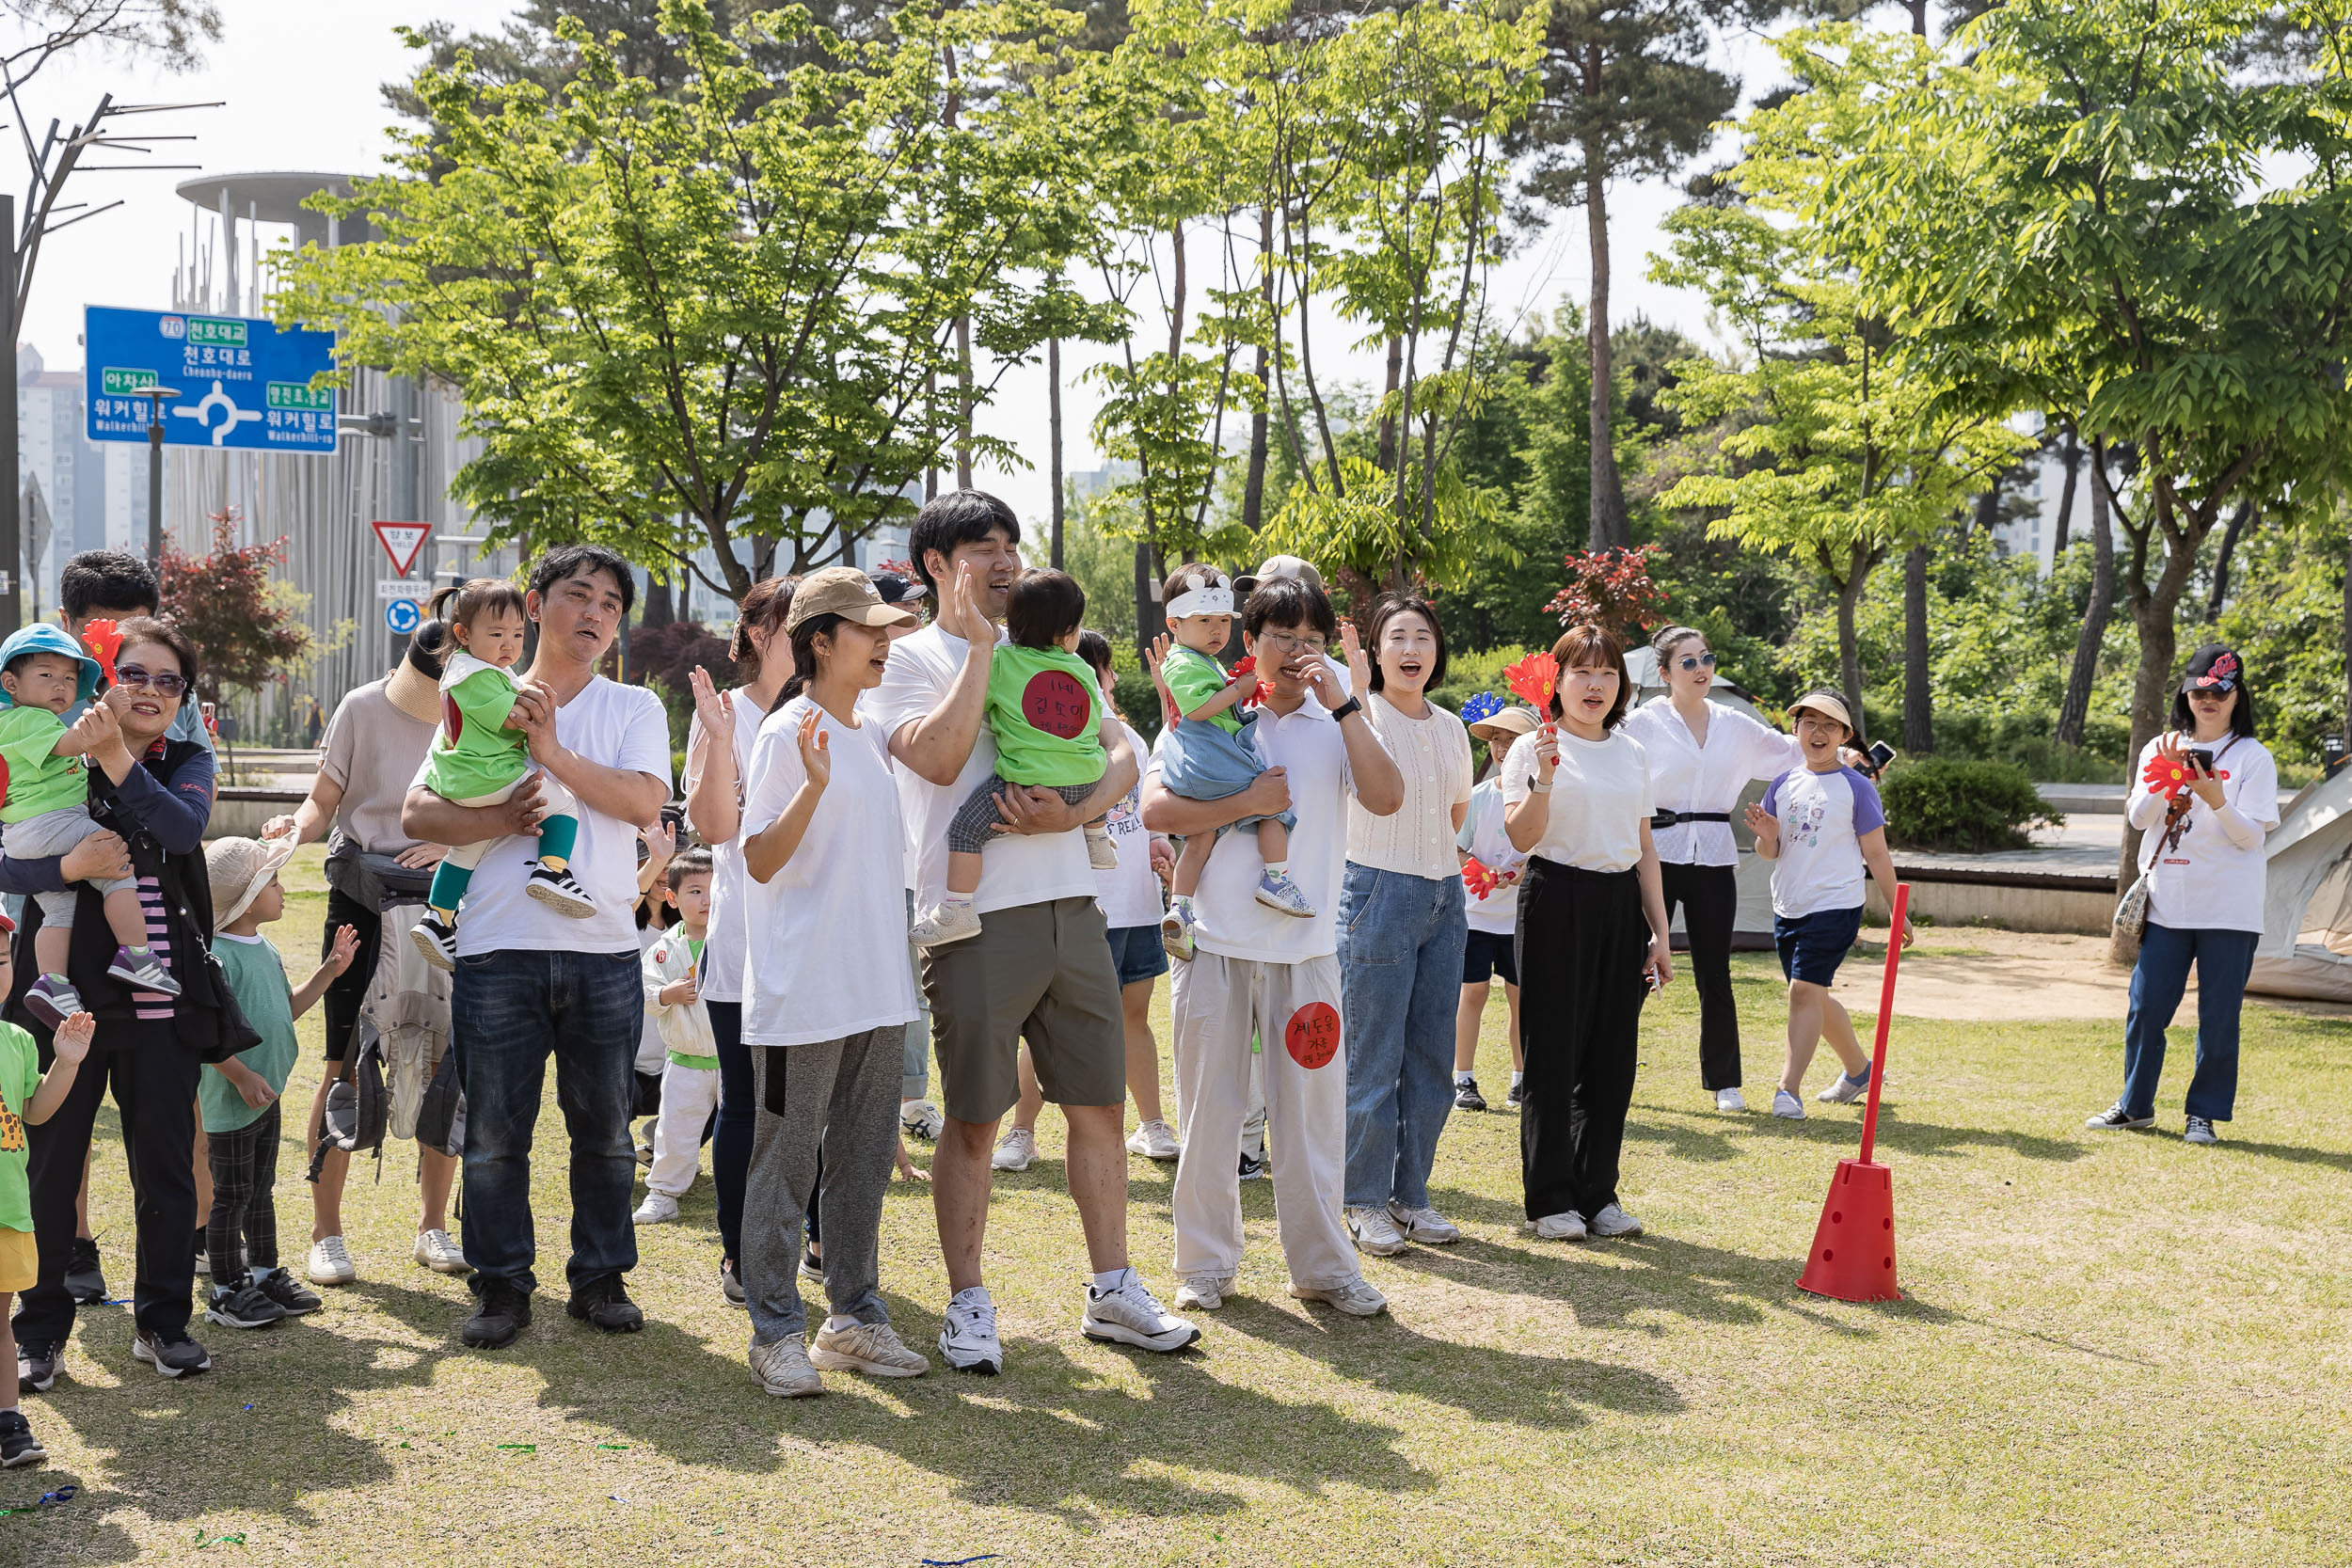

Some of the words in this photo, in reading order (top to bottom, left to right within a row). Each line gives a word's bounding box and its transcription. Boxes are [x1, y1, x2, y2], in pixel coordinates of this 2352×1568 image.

[165, 322, 182, 336] 70
[191, 322, 246, 341] 천호대교
[183, 344, 252, 366] 천호대로
[183, 364, 253, 381] Cheonho-daero
[94, 399, 167, 422] 워커힐로
[96, 420, 151, 433] Walkerhill
[266, 410, 334, 433] 워커힐로
[267, 430, 333, 445] Walkerhill-ro
[1309, 1037, 1327, 1051] 가족
